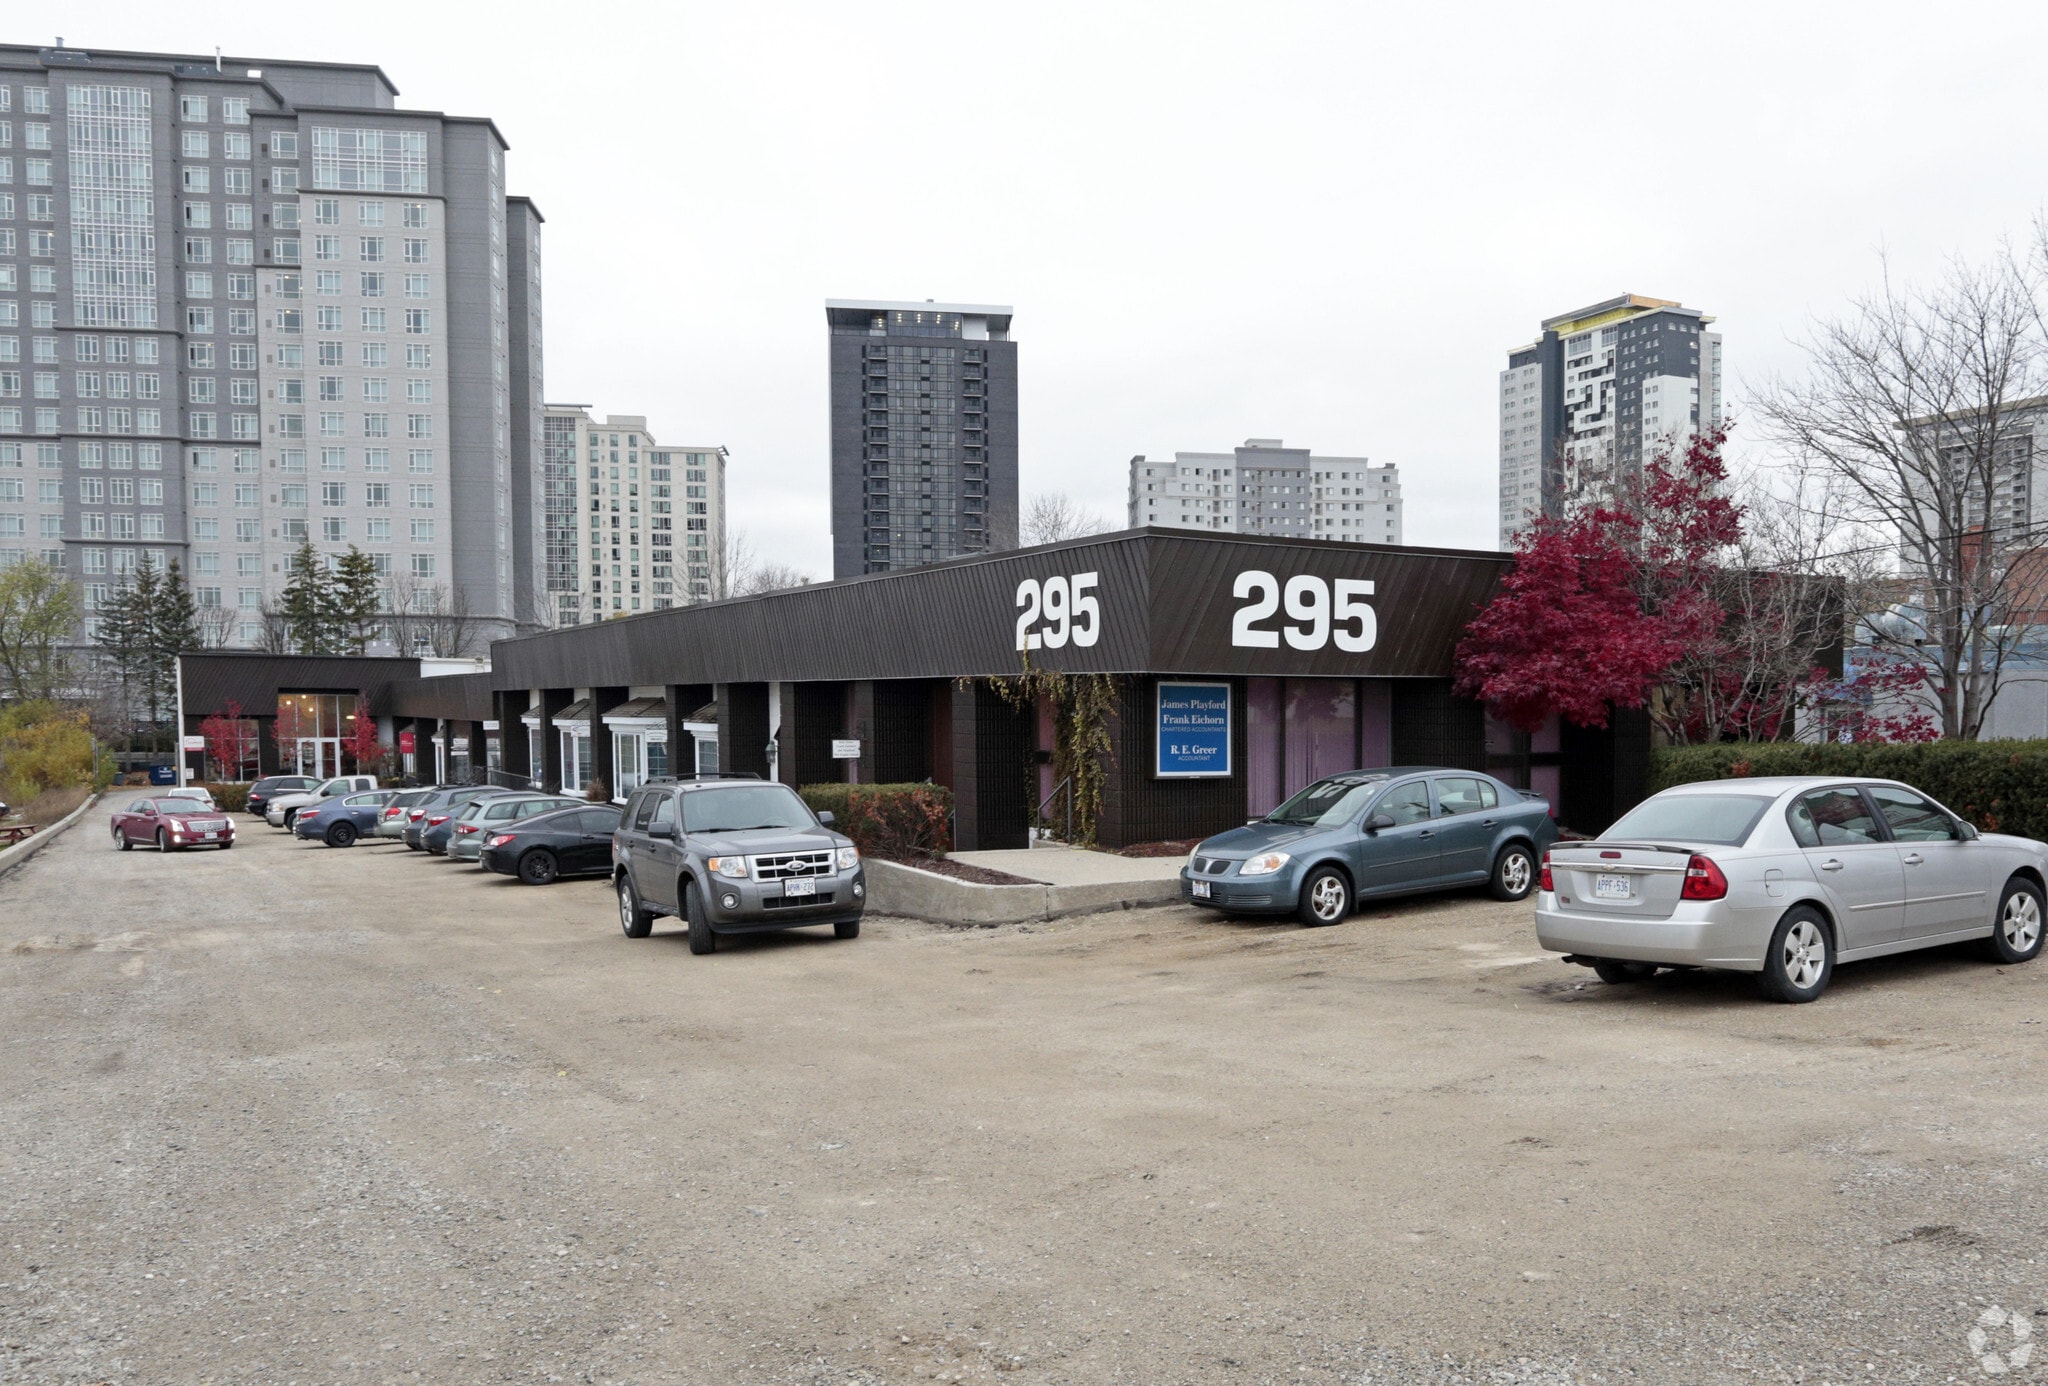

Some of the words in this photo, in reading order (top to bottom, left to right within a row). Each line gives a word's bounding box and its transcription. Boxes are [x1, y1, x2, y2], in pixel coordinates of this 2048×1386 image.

[1016, 571, 1099, 651] 295
[1232, 570, 1377, 652] 295
[1161, 700, 1189, 709] James
[1190, 700, 1226, 711] Playford
[1163, 715, 1190, 724] Frank
[1191, 715, 1224, 725] Eichorn
[1170, 745, 1180, 754] R.
[1182, 745, 1190, 754] E.
[1192, 745, 1217, 754] Greer
